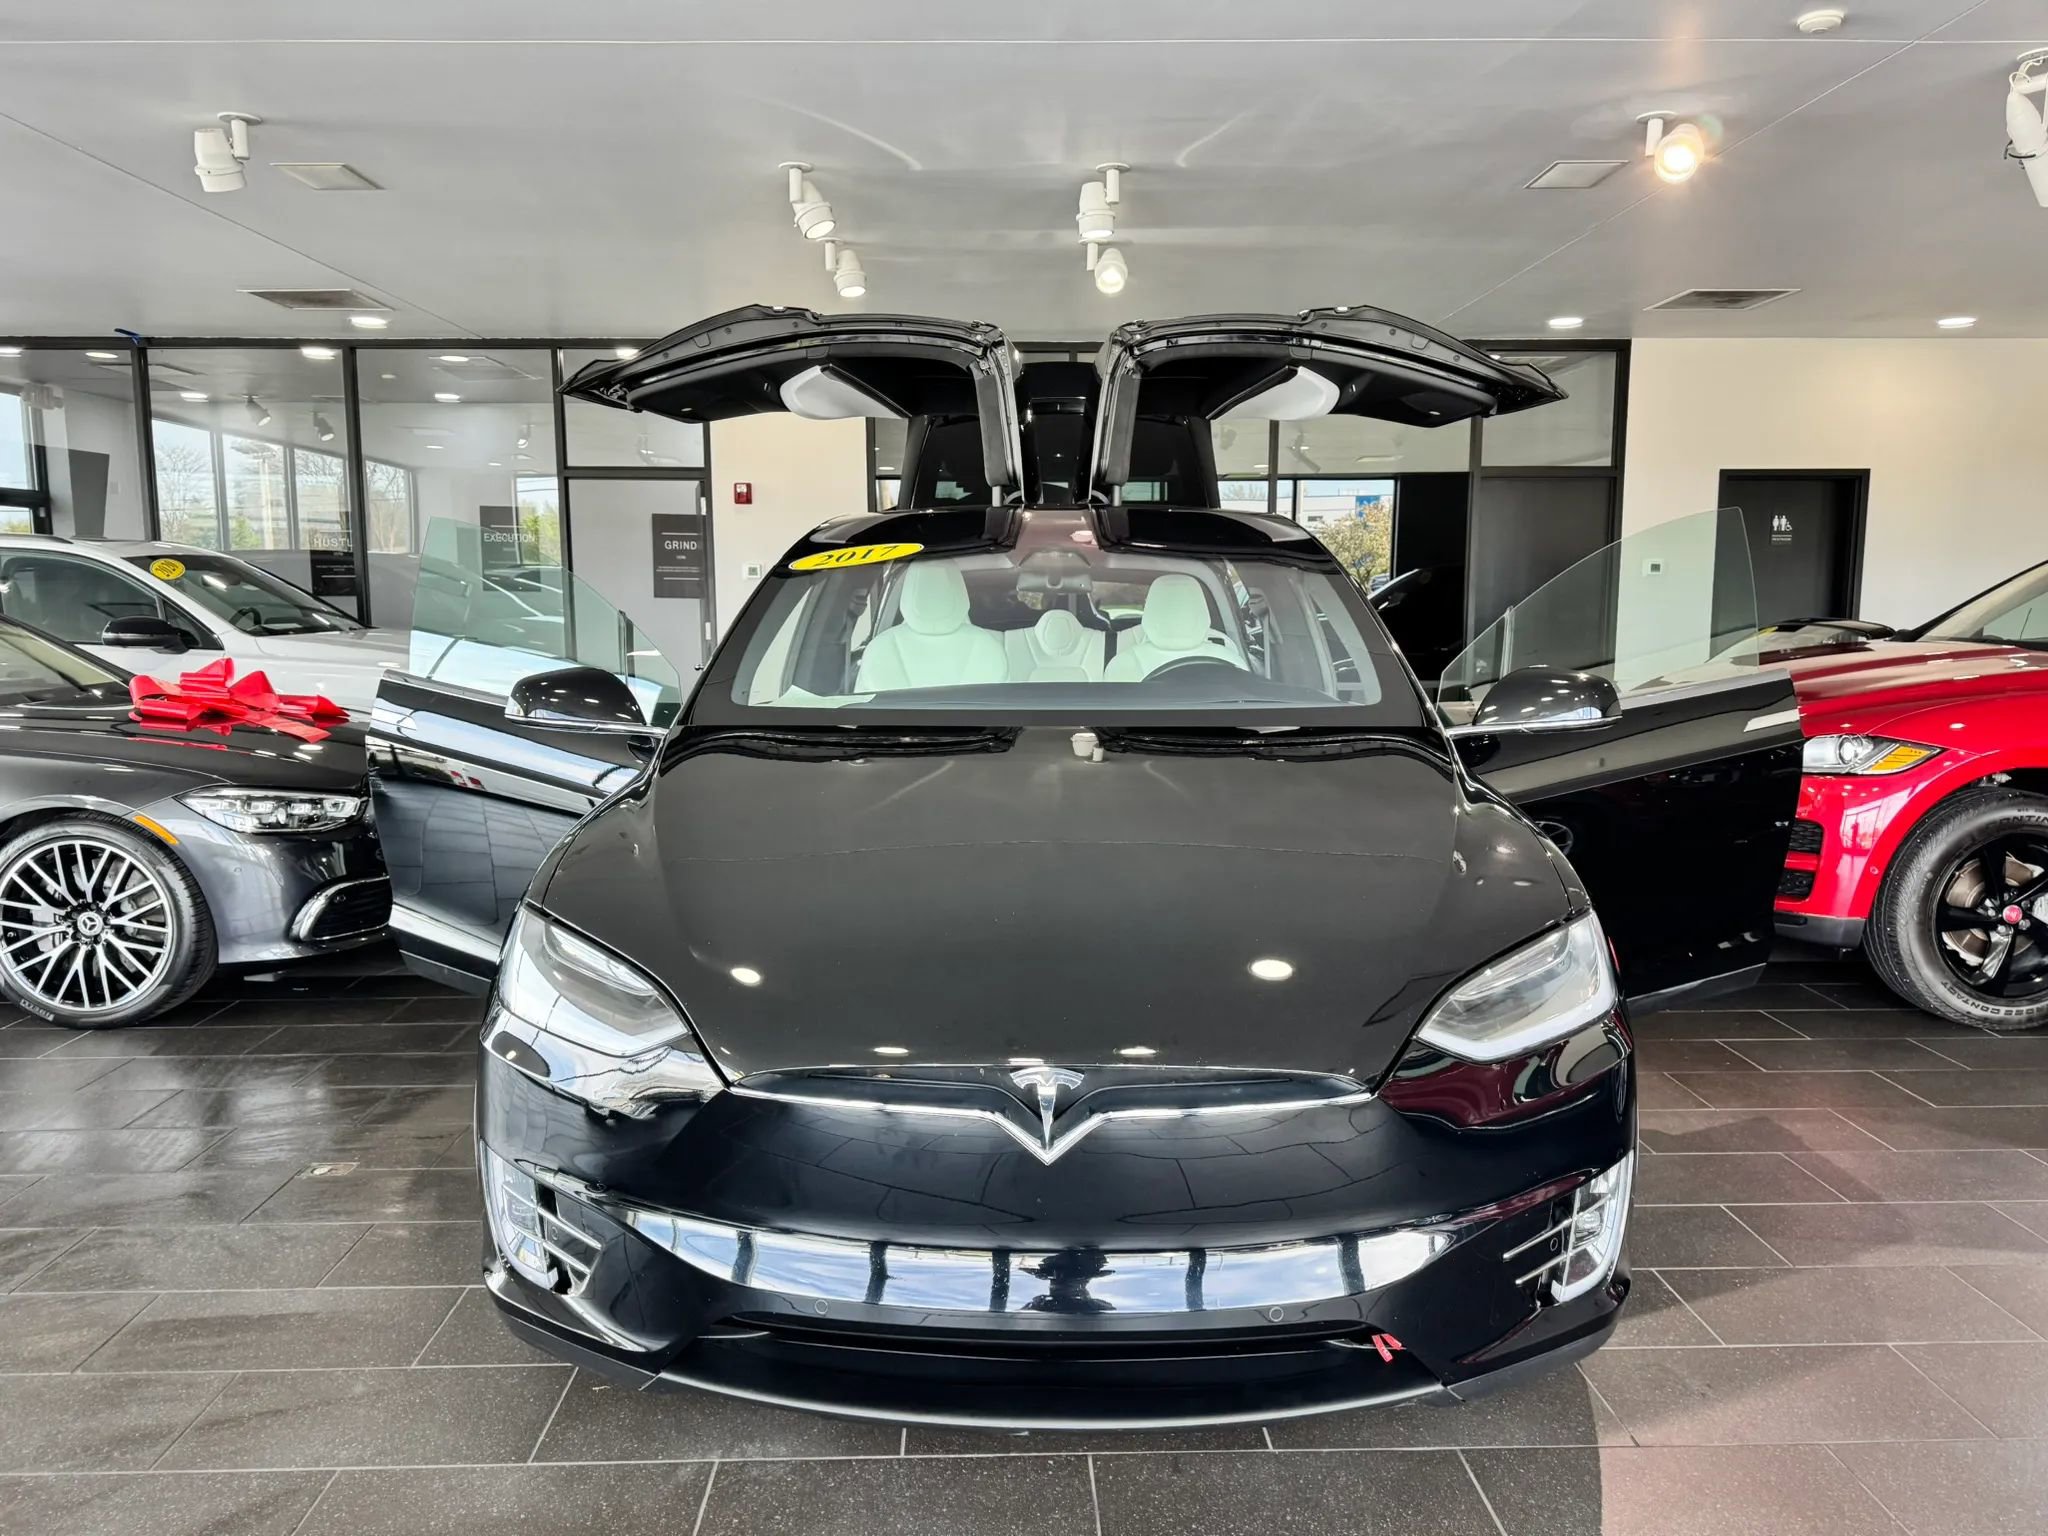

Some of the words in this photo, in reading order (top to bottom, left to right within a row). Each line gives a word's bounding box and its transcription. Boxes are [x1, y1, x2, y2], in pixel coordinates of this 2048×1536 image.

[483, 532, 536, 543] EXECUTION
[664, 540, 698, 550] GRIND
[811, 545, 899, 568] 2017
[1940, 981, 2001, 1015] CONTACT
